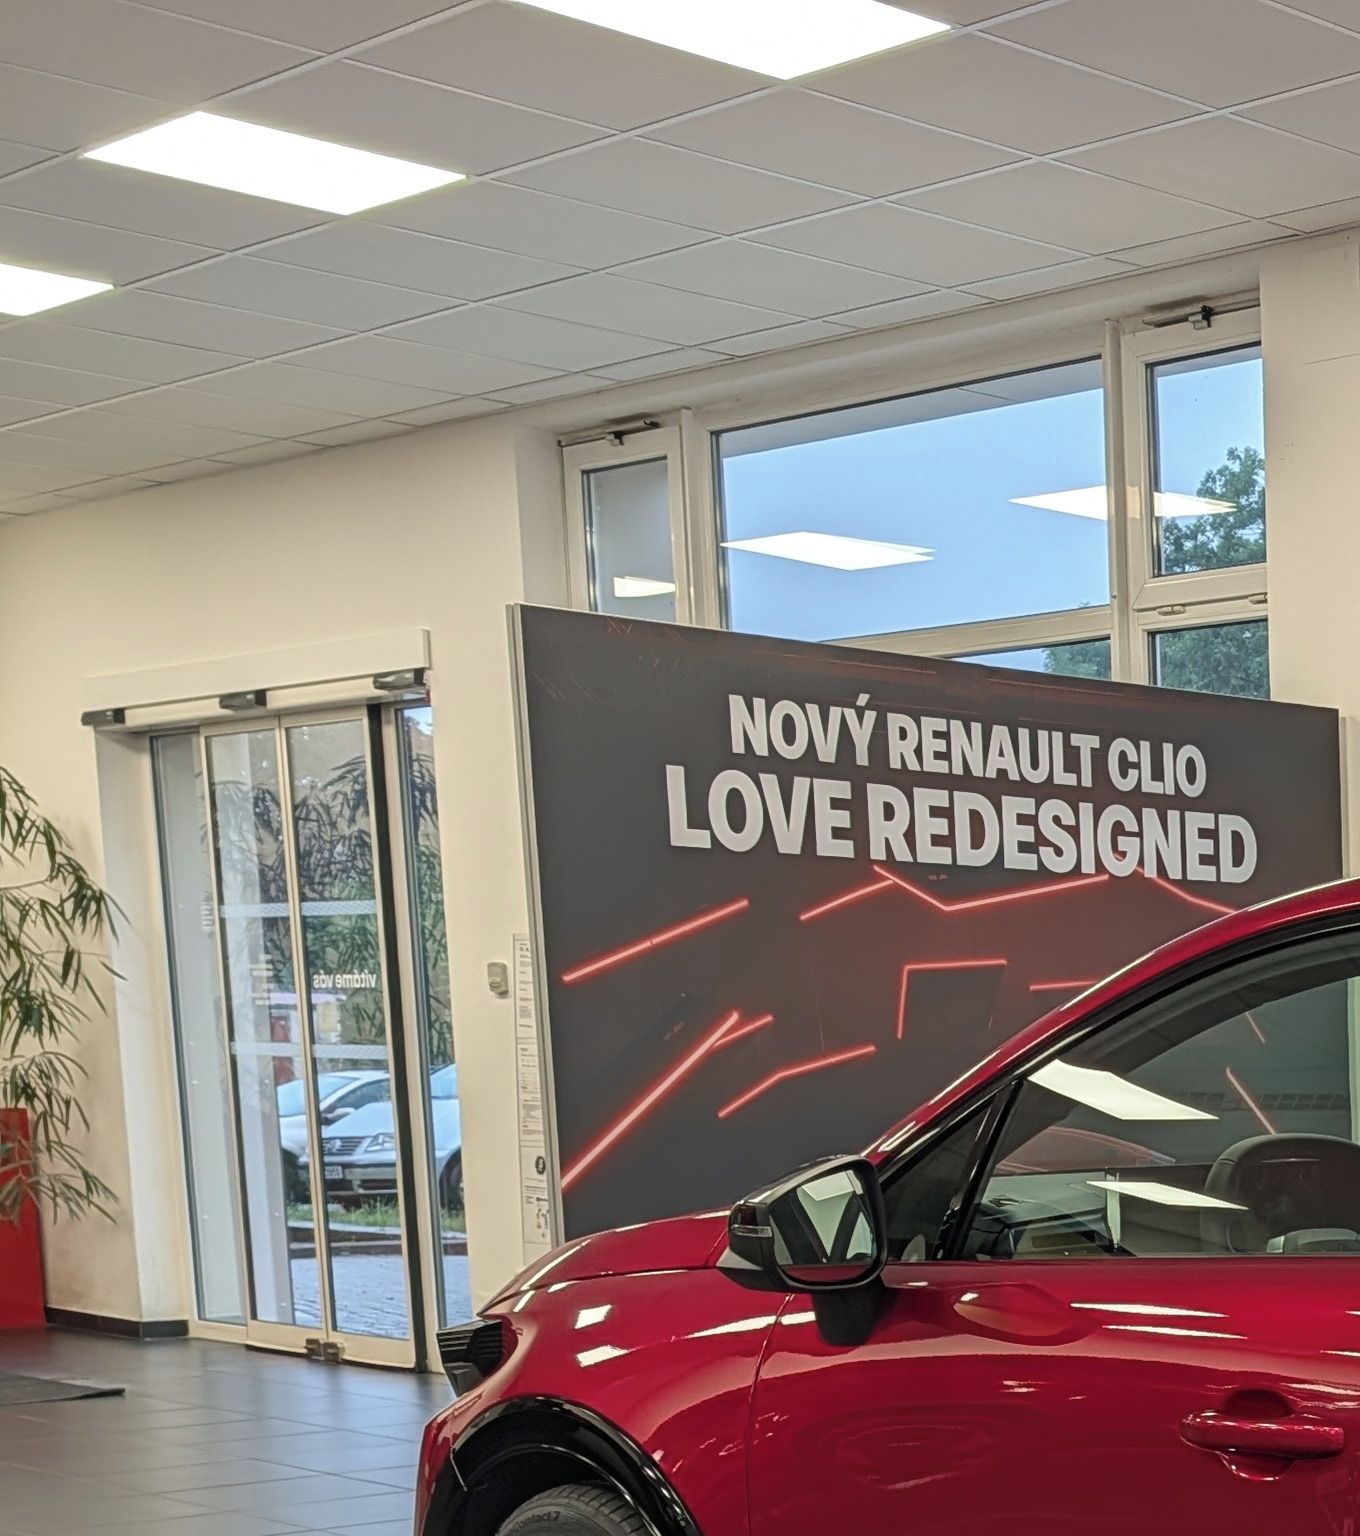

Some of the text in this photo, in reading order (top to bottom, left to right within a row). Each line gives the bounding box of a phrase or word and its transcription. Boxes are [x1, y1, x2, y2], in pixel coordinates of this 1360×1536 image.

[728, 694, 1207, 798] NOVÝ RENAULT CLIO
[665, 764, 1258, 884] LOVE REDESIGNED
